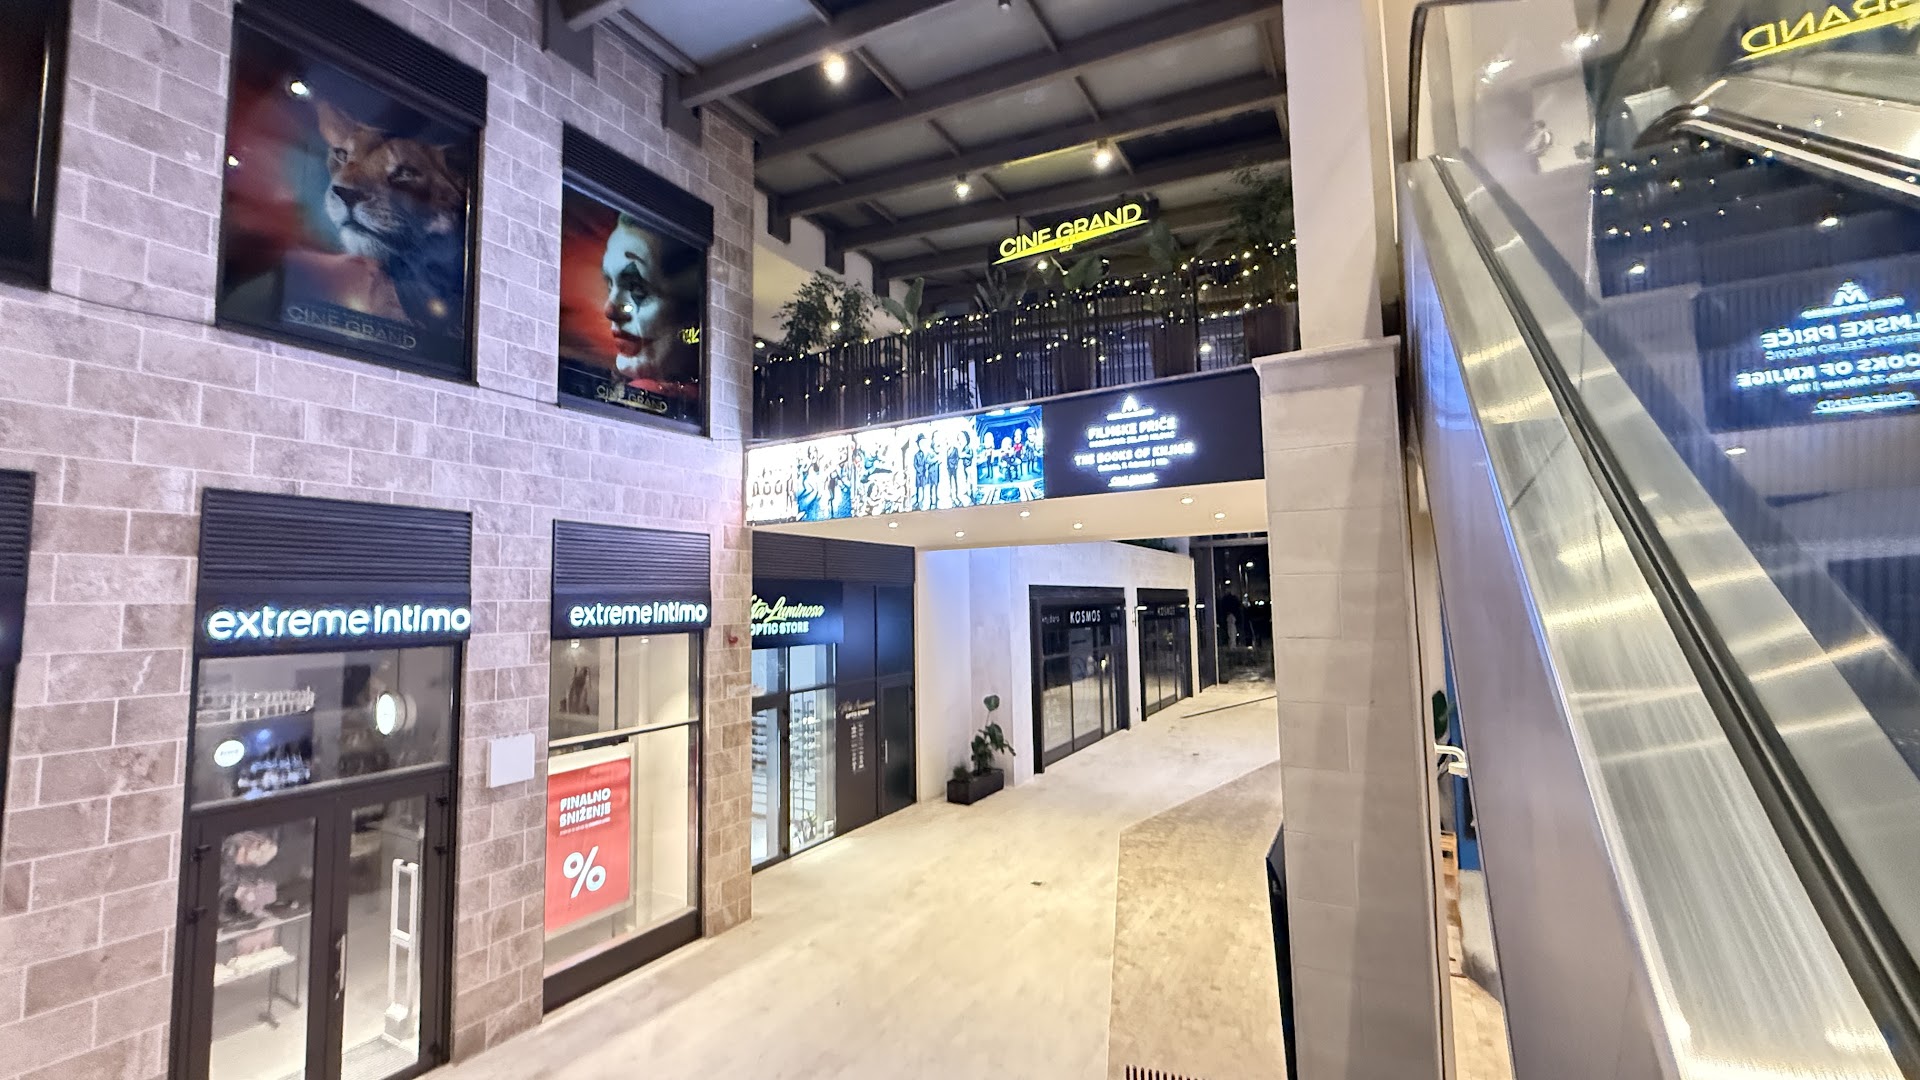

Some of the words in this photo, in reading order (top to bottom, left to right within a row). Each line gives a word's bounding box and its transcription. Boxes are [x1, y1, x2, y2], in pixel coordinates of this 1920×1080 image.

[1000, 228, 1051, 257] CINE
[1056, 203, 1142, 240] GRAND
[287, 306, 339, 326] CINE
[345, 320, 416, 349] GRAND
[764, 596, 825, 624] Luminosa
[1070, 610, 1101, 624] KOSMOS
[779, 620, 809, 635] STORE
[560, 788, 612, 812] FINALNO
[559, 802, 612, 828] SNIŽENJE
